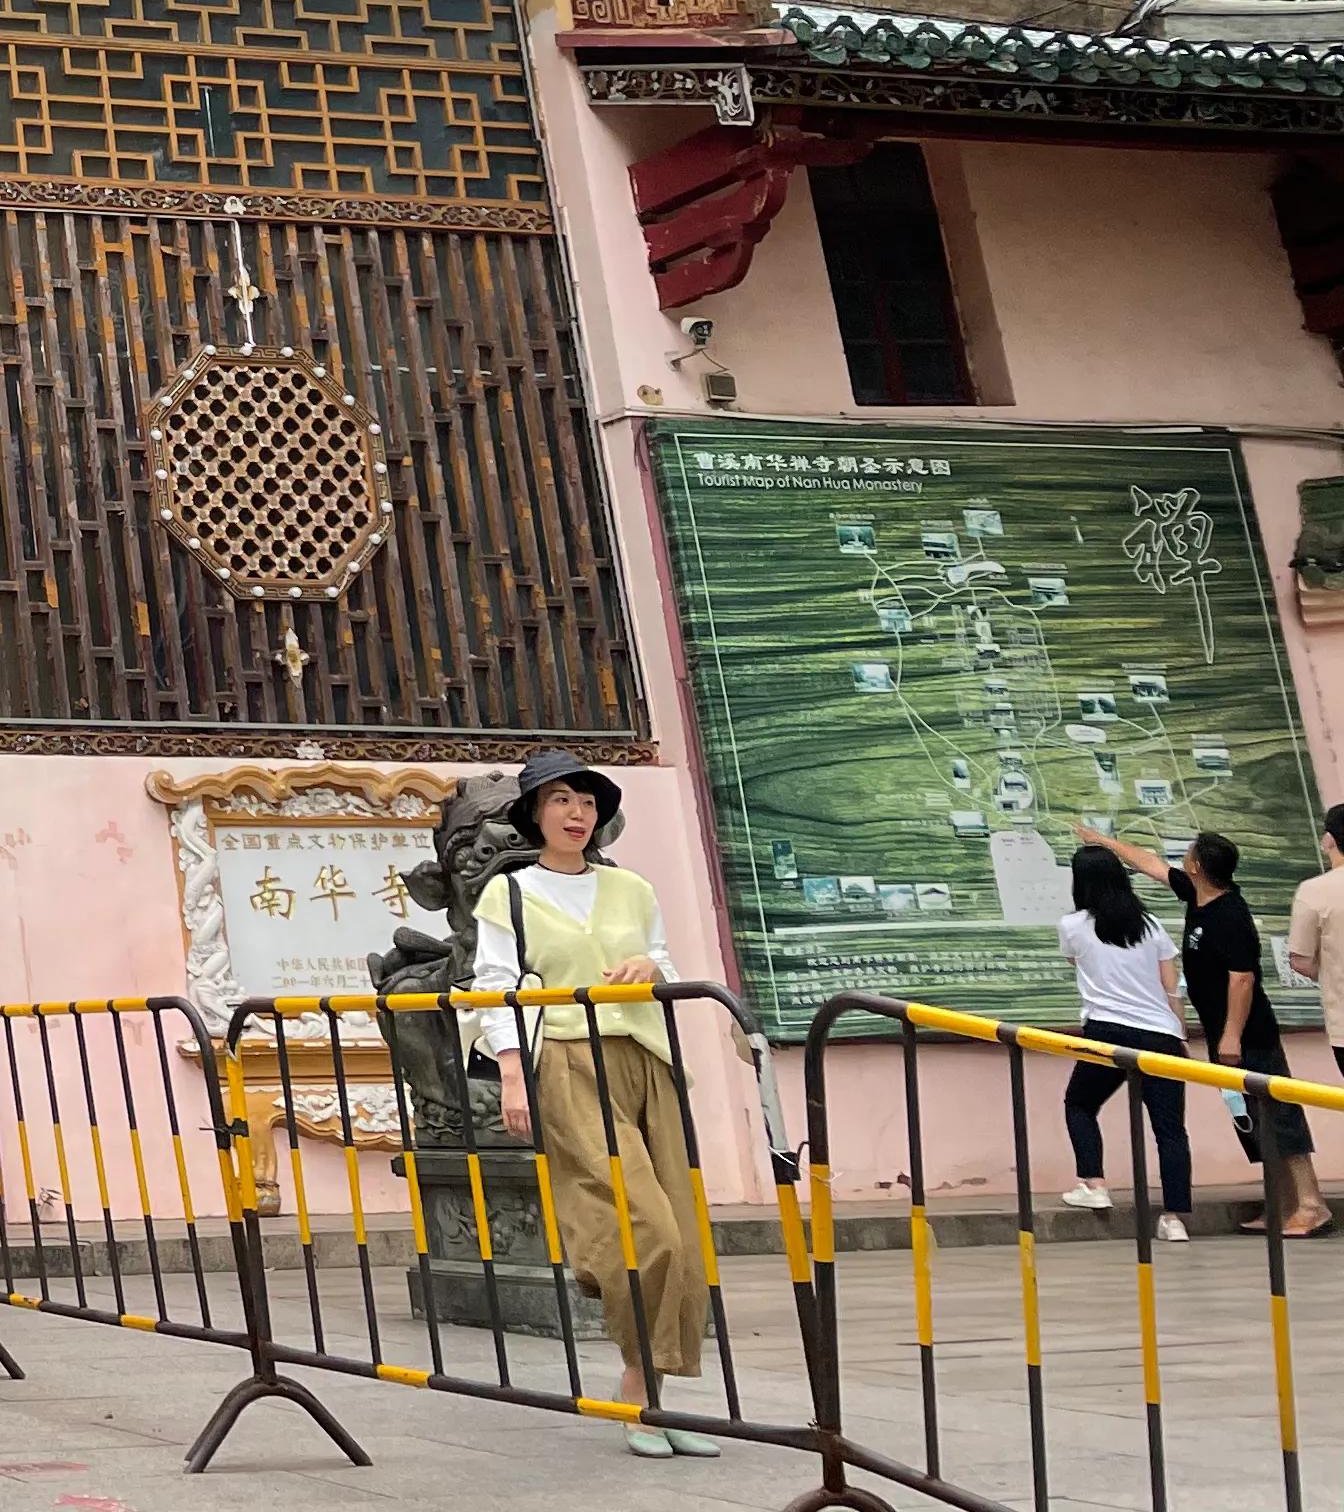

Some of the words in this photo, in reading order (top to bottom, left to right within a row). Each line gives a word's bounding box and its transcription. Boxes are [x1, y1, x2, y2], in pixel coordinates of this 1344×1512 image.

[697, 473, 740, 487] Tourist
[742, 475, 775, 490] Map
[777, 475, 791, 488] of
[793, 476, 821, 489] Nan
[823, 477, 850, 489] Hua
[852, 477, 922, 494] Monastery
[250, 864, 410, 921] 南华寺
